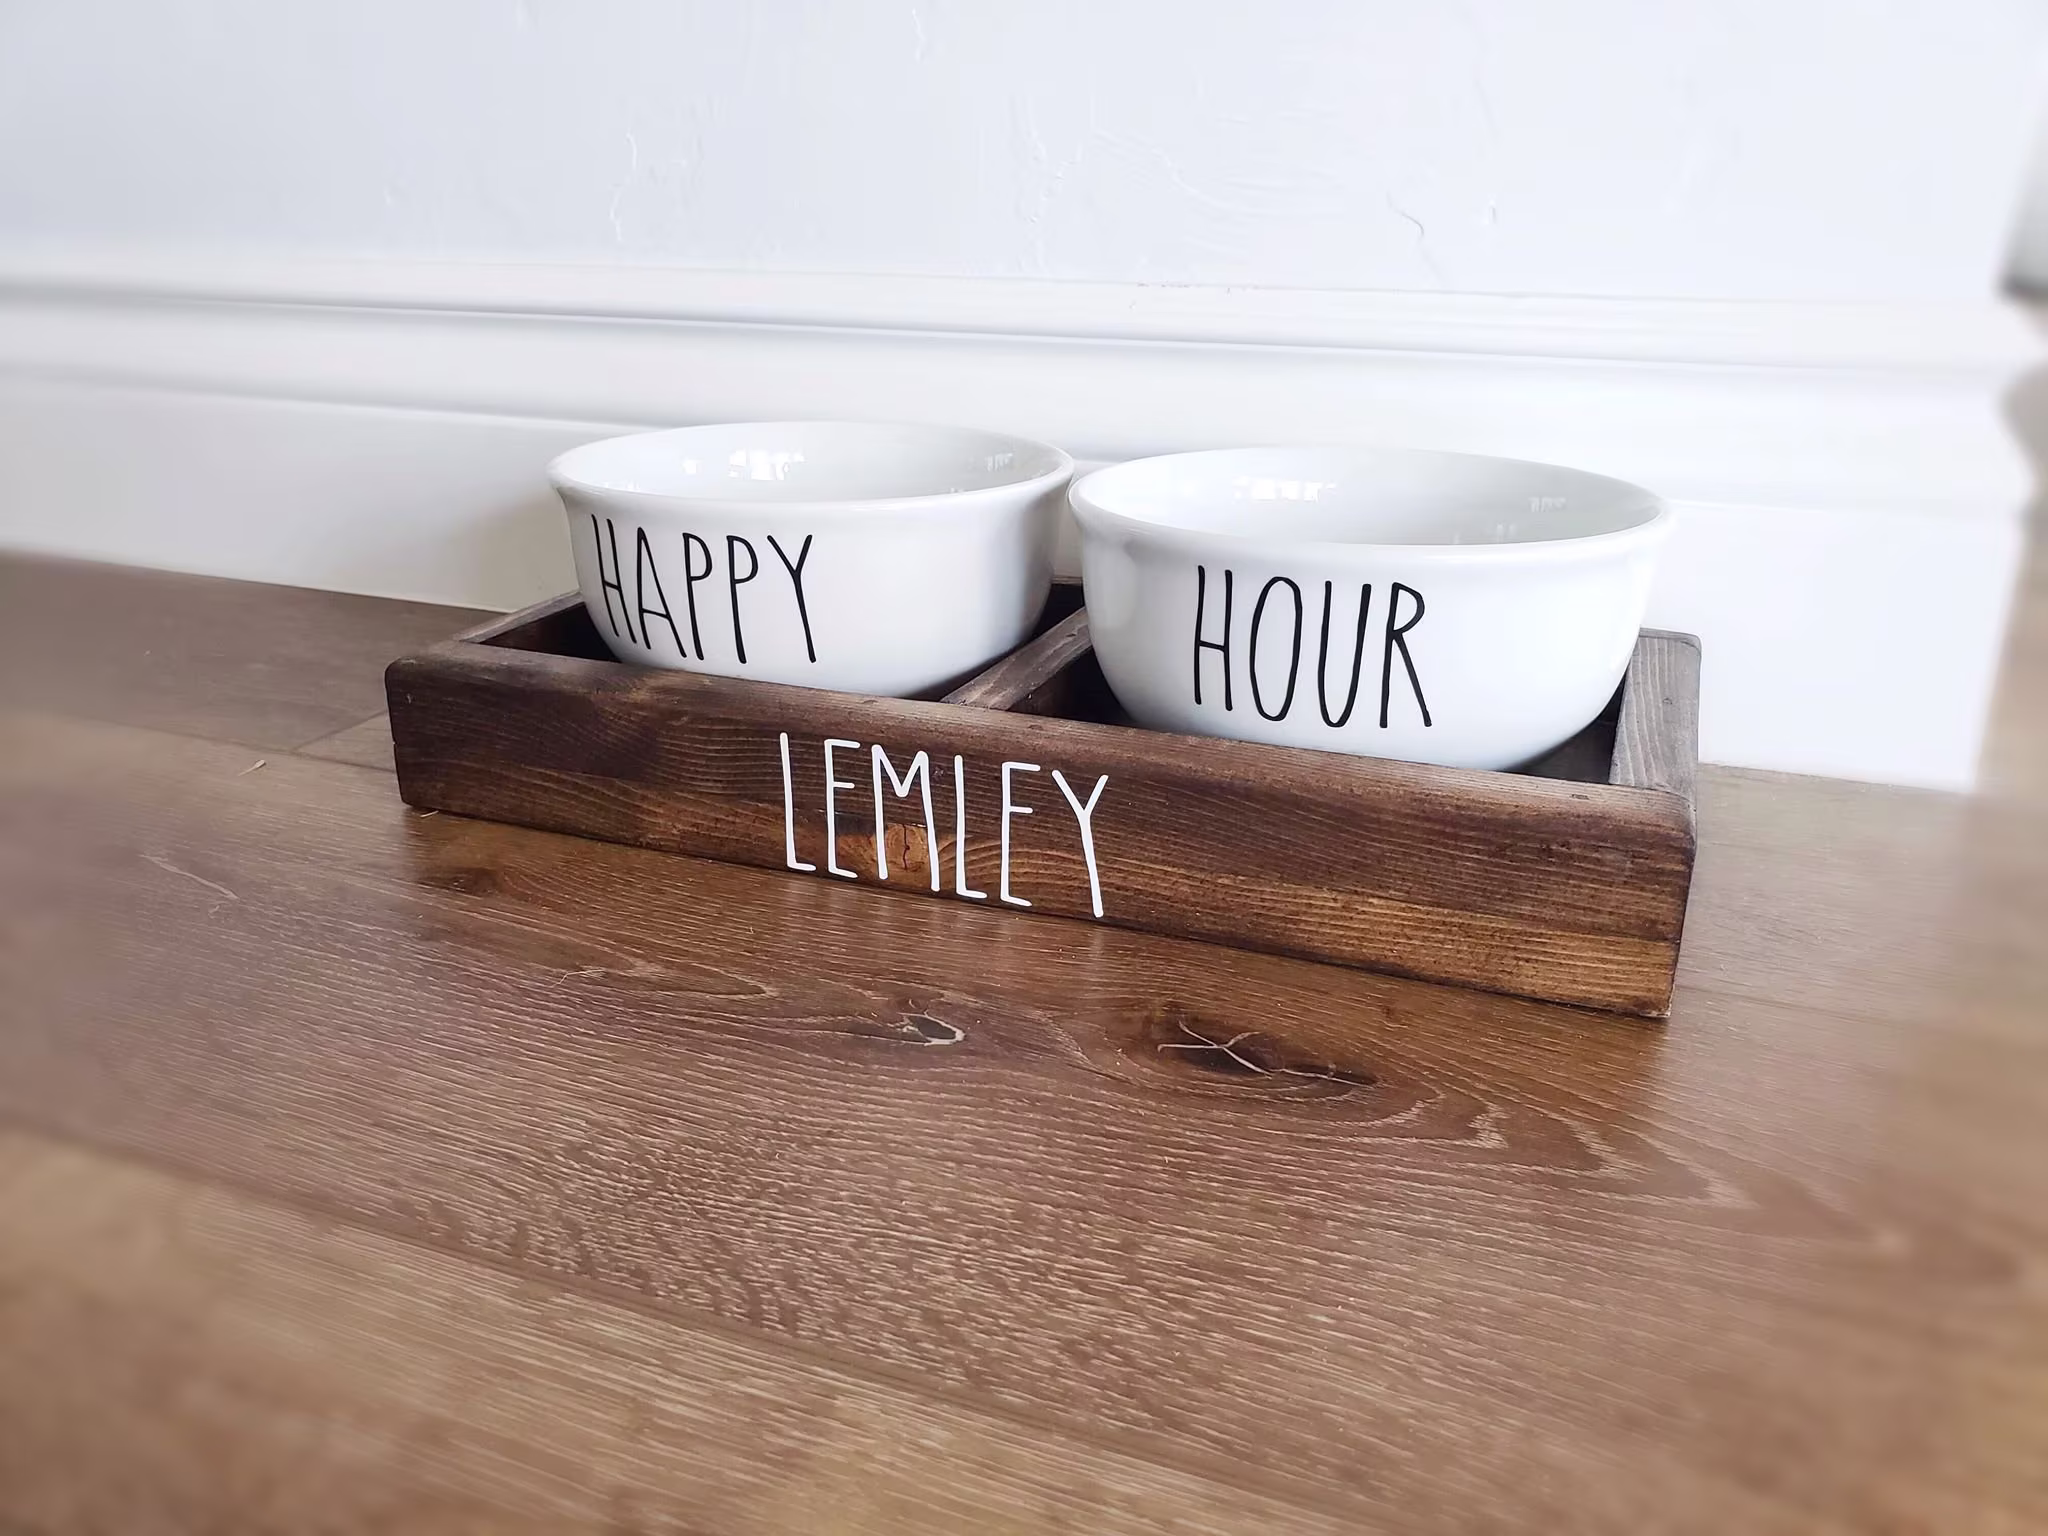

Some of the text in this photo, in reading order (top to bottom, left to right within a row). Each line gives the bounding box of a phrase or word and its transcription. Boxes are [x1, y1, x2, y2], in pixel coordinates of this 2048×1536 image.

[591, 513, 817, 664] HAPPY
[1194, 565, 1432, 728] HOUR
[779, 732, 1109, 918] LEMLEY
